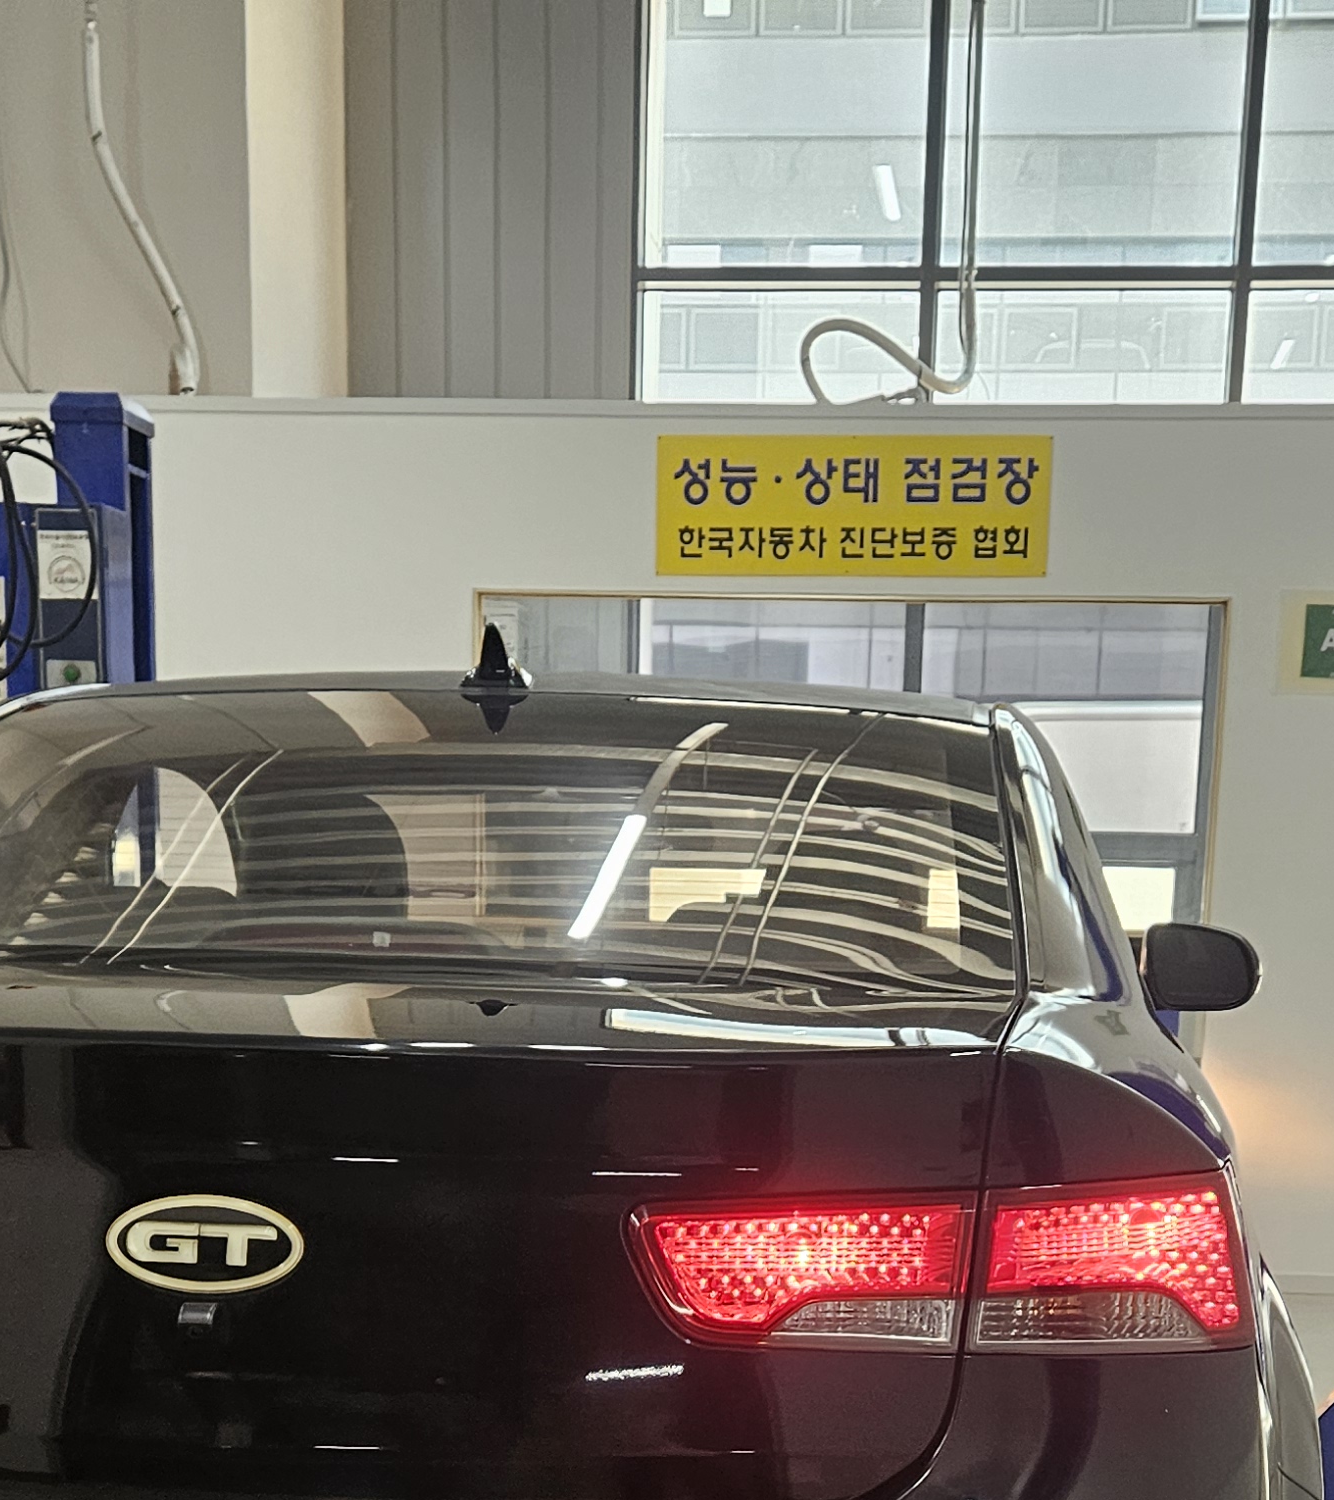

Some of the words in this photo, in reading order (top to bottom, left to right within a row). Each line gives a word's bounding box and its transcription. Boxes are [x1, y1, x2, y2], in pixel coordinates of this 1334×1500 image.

[903, 456, 1040, 505] 점검장
[678, 525, 827, 560] 한국자동차
[839, 525, 958, 560] 진단보증
[972, 525, 1030, 559] 협회
[126, 1220, 279, 1267] GT
